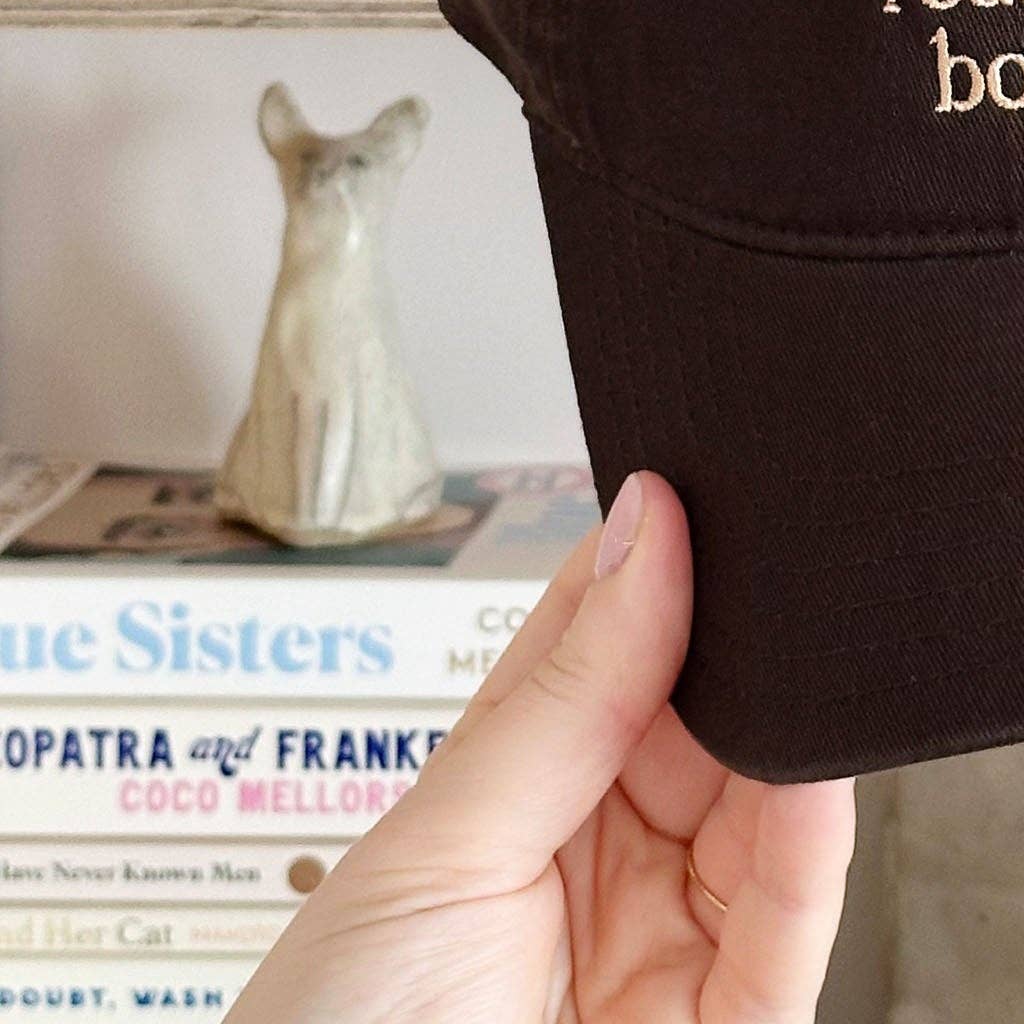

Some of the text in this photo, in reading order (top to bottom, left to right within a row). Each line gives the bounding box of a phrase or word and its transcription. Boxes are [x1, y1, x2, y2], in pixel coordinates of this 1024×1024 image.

[115, 600, 395, 675] Sisters
[189, 726, 260, 776] and
[119, 779, 220, 814] COCO
[116, 916, 174, 945] Cat
[132, 987, 222, 1008] WASH
